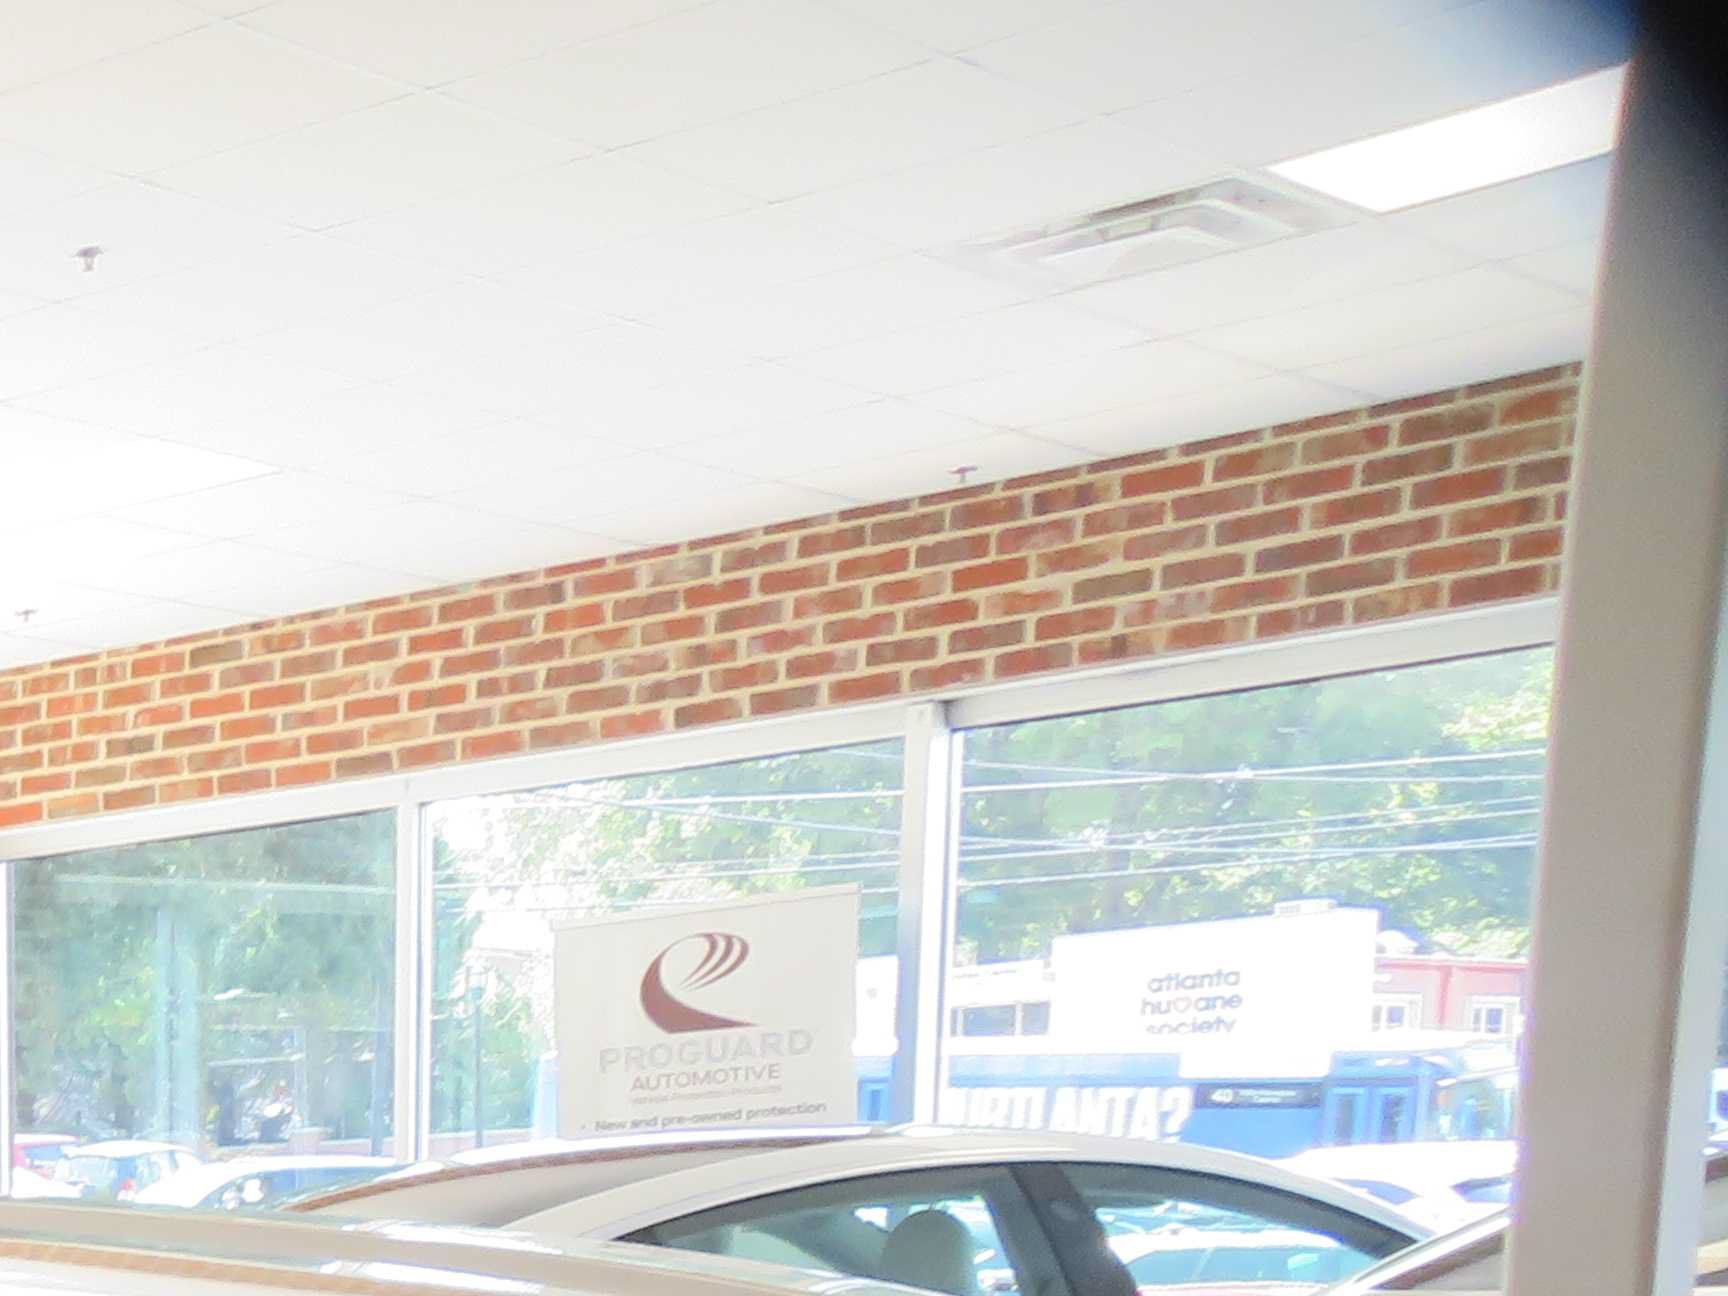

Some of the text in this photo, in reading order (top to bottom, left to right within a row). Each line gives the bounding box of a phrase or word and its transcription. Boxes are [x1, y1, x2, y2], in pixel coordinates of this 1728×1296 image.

[1147, 968, 1241, 993] atlanta
[599, 1028, 814, 1073] PROGUARD
[631, 1063, 780, 1093] AUTOMOTIVE
[594, 1119, 627, 1132] New
[661, 1109, 743, 1128] pre-owned
[748, 1101, 828, 1121] protection
